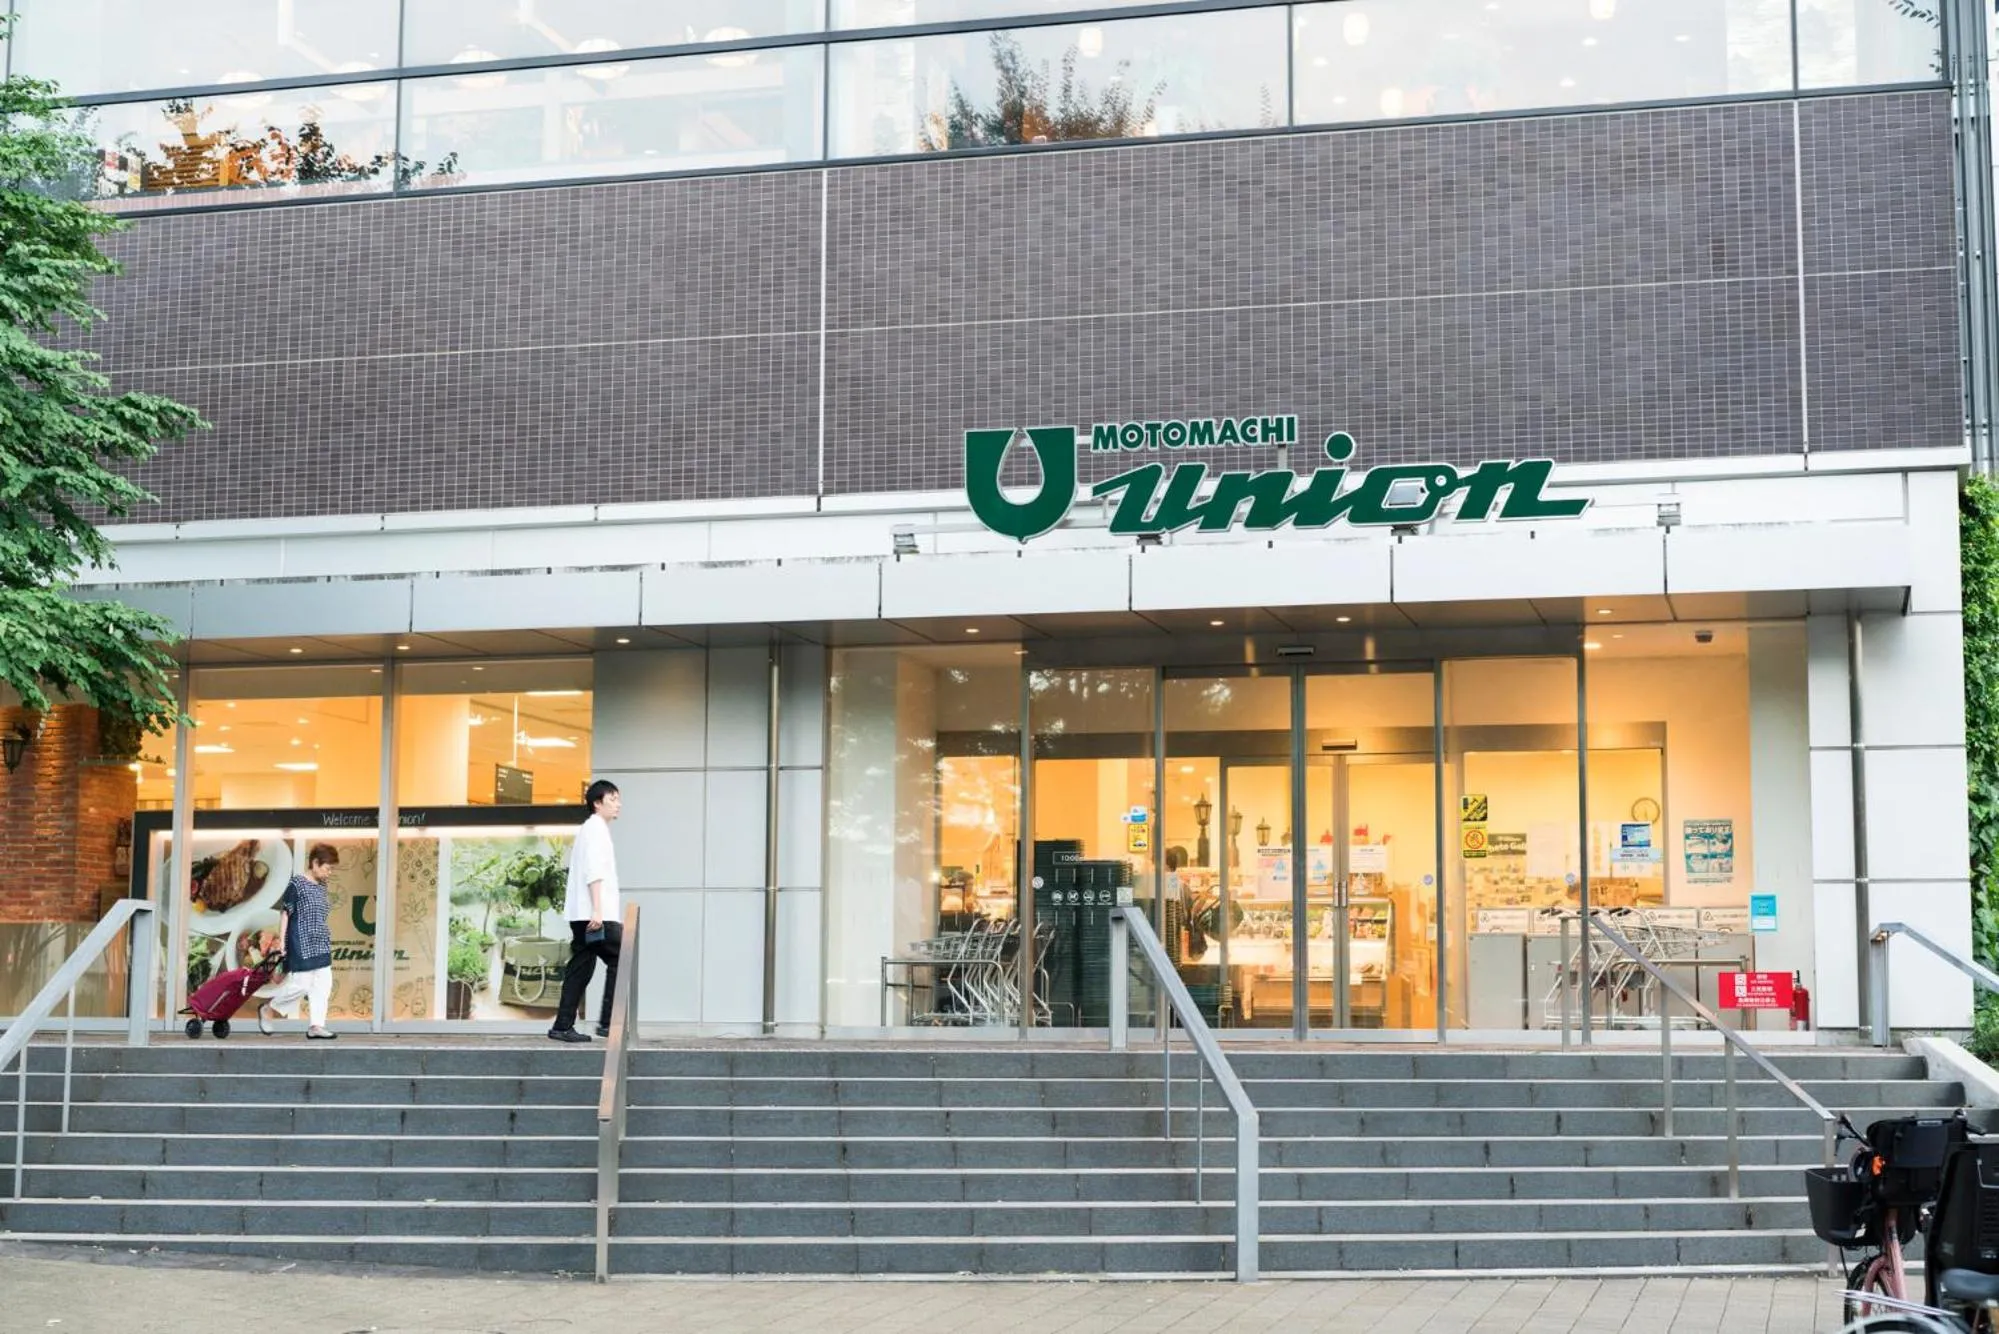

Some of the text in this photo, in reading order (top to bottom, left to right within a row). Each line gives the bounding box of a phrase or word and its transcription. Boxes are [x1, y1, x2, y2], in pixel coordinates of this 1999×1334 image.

[1092, 414, 1297, 453] MOTOMACHI
[1092, 431, 1595, 536] union
[322, 812, 370, 826] Welcome
